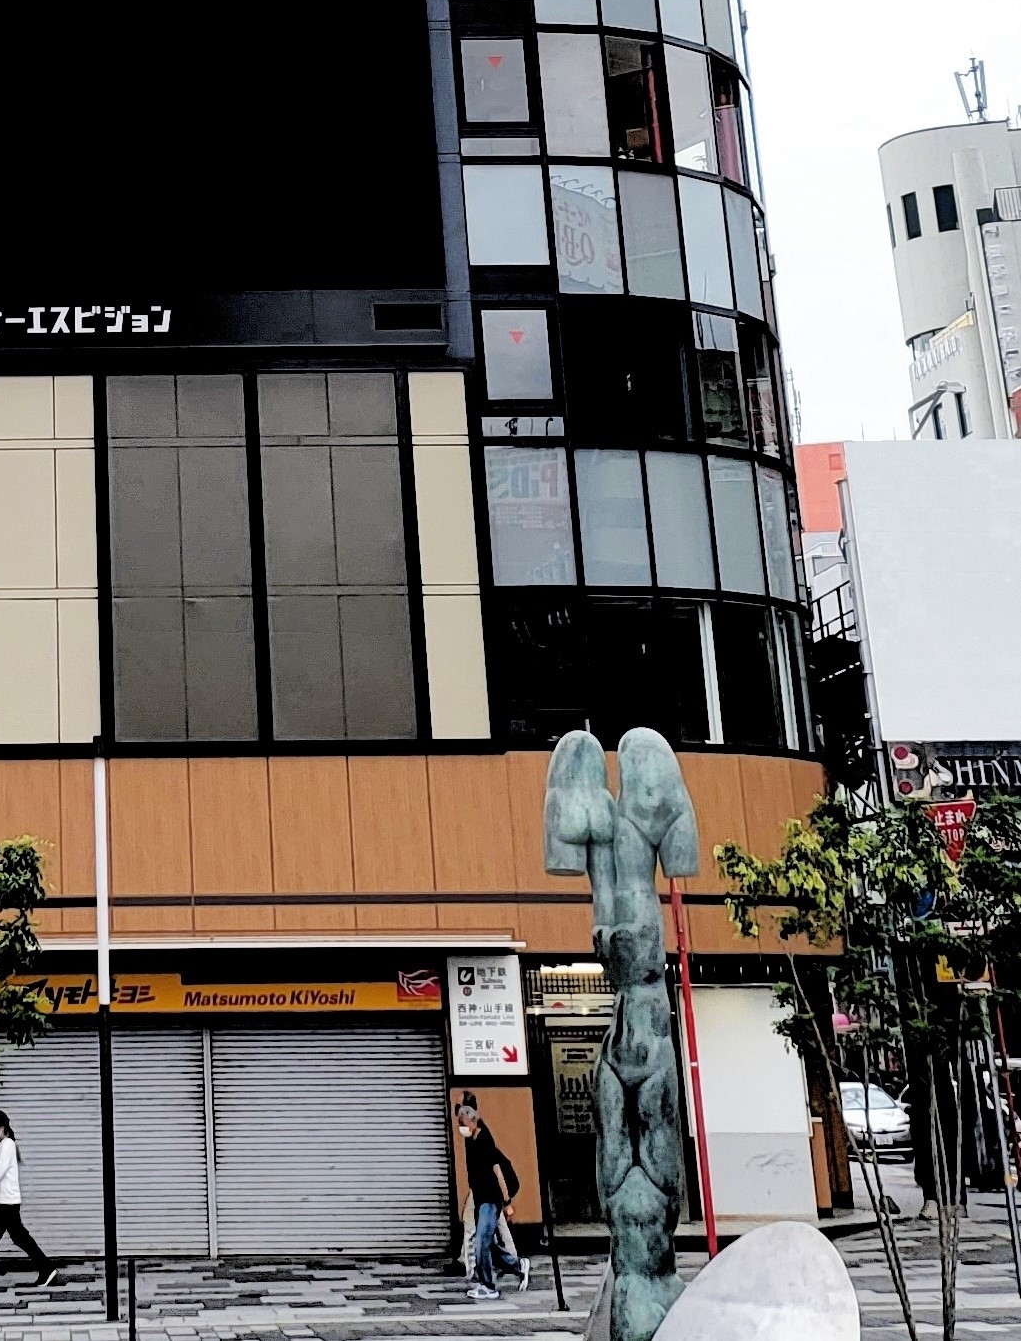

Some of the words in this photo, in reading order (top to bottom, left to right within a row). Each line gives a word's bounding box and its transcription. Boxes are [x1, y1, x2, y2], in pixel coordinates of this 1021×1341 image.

[934, 809, 967, 827] 止まれ
[941, 827, 965, 843] STOP
[184, 990, 287, 1007] Matsumoto
[289, 989, 356, 1005] KiYoshi
